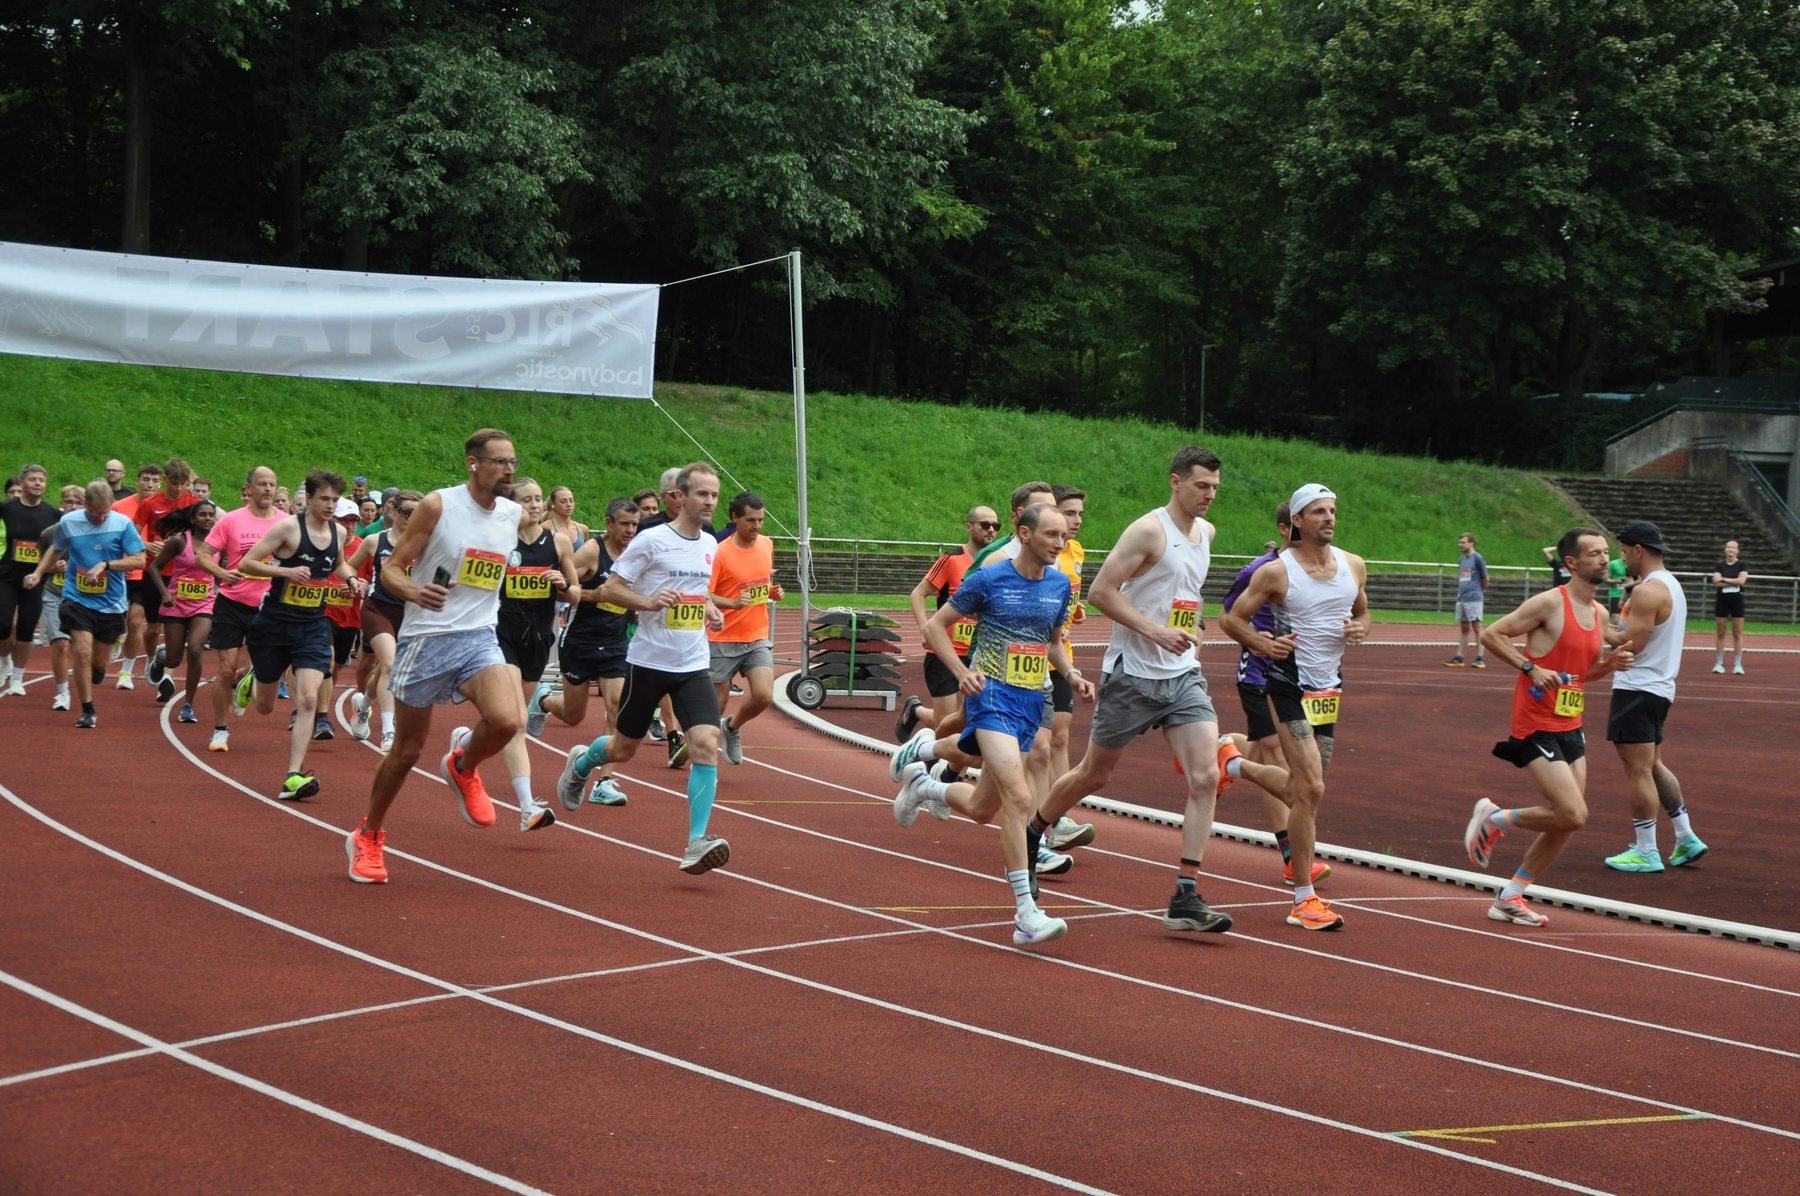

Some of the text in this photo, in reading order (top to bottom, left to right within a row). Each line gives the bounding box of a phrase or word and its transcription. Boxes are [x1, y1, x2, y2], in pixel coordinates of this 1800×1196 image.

[18, 547, 40, 558] 105
[466, 558, 503, 581] 1038
[180, 582, 207, 594] 1083
[510, 575, 548, 590] 1069
[290, 585, 321, 600] 1063
[673, 605, 704, 621] 1076
[1173, 610, 1197, 628] 105
[1012, 655, 1045, 674] 1031
